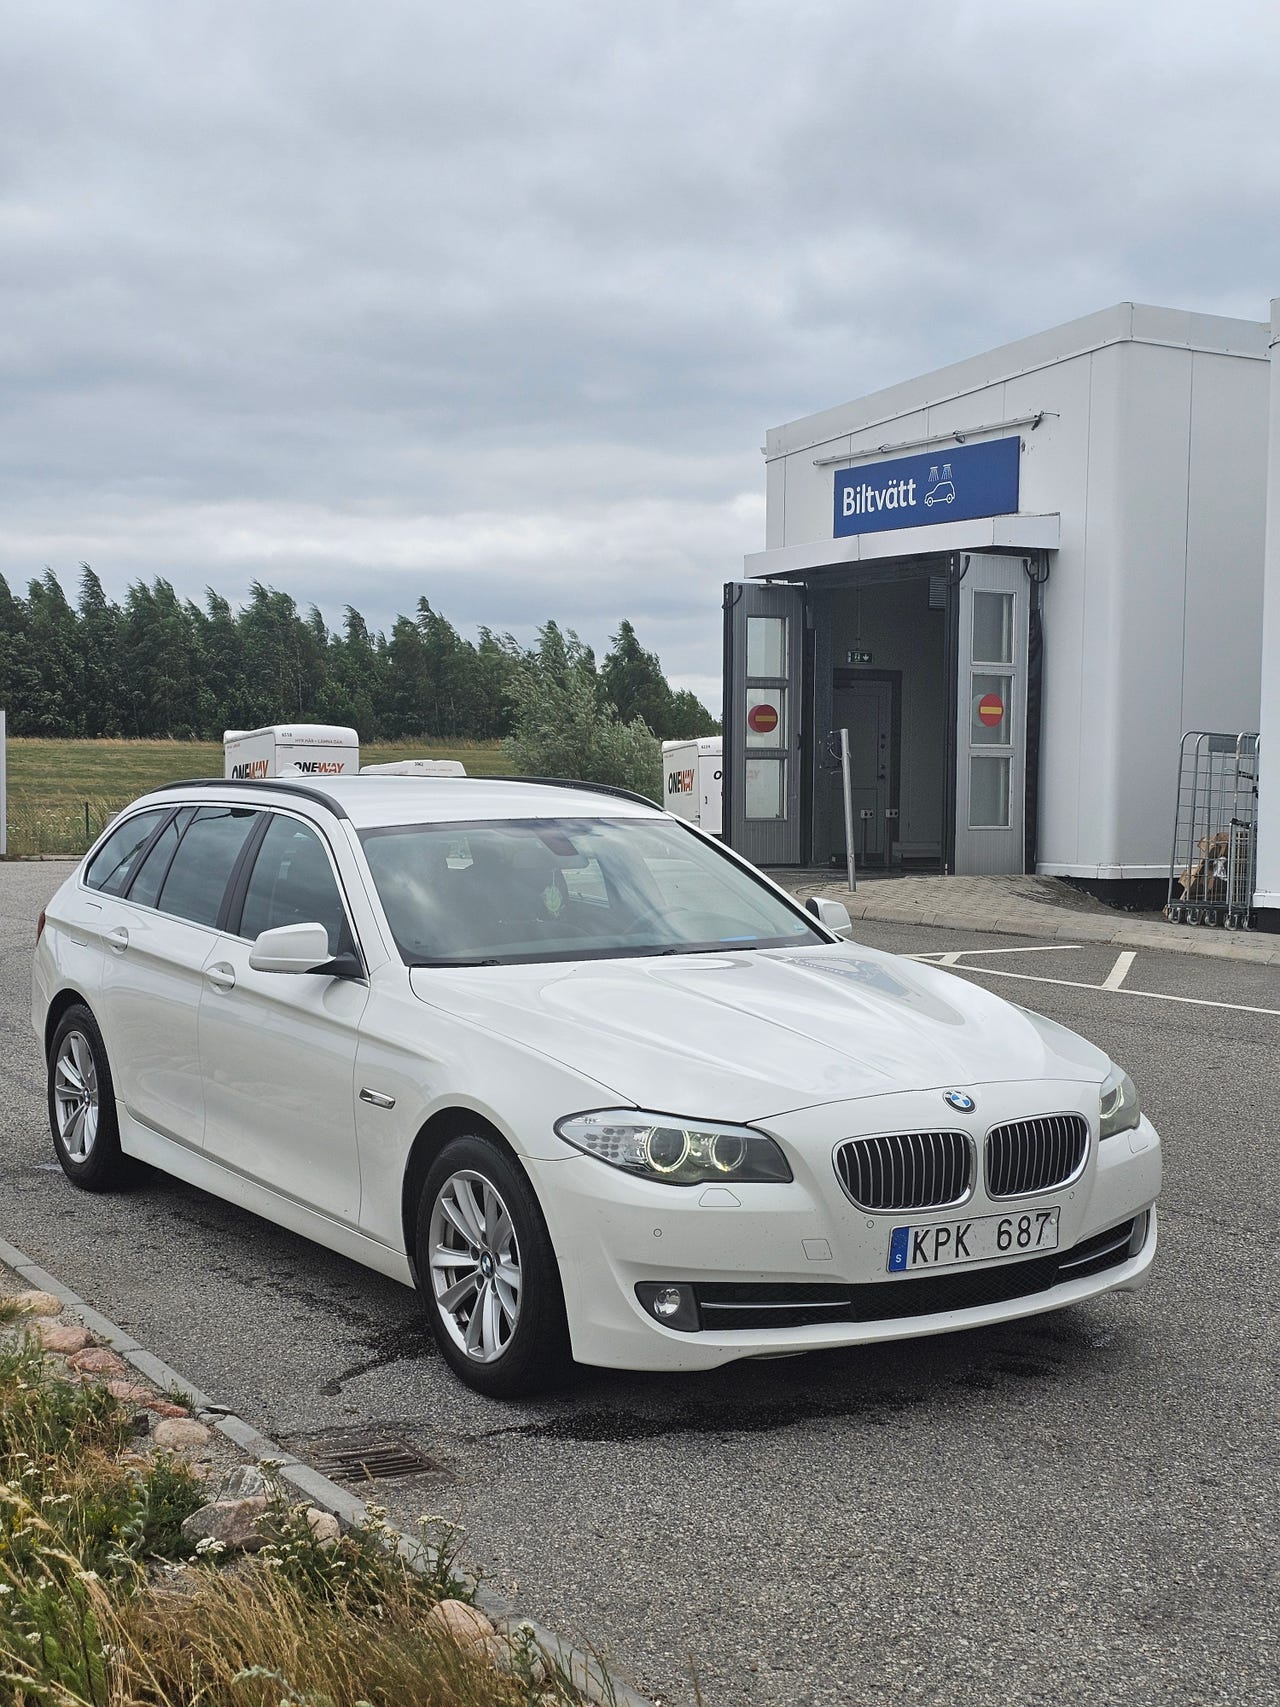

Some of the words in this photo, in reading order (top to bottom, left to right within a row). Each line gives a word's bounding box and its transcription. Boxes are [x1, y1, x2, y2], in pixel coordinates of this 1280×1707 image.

[842, 478, 917, 517] Biltvätt
[668, 769, 695, 794] ONEWAY
[911, 1223, 972, 1265] KPK
[996, 1212, 1052, 1251] 687
[895, 1254, 902, 1263] S
